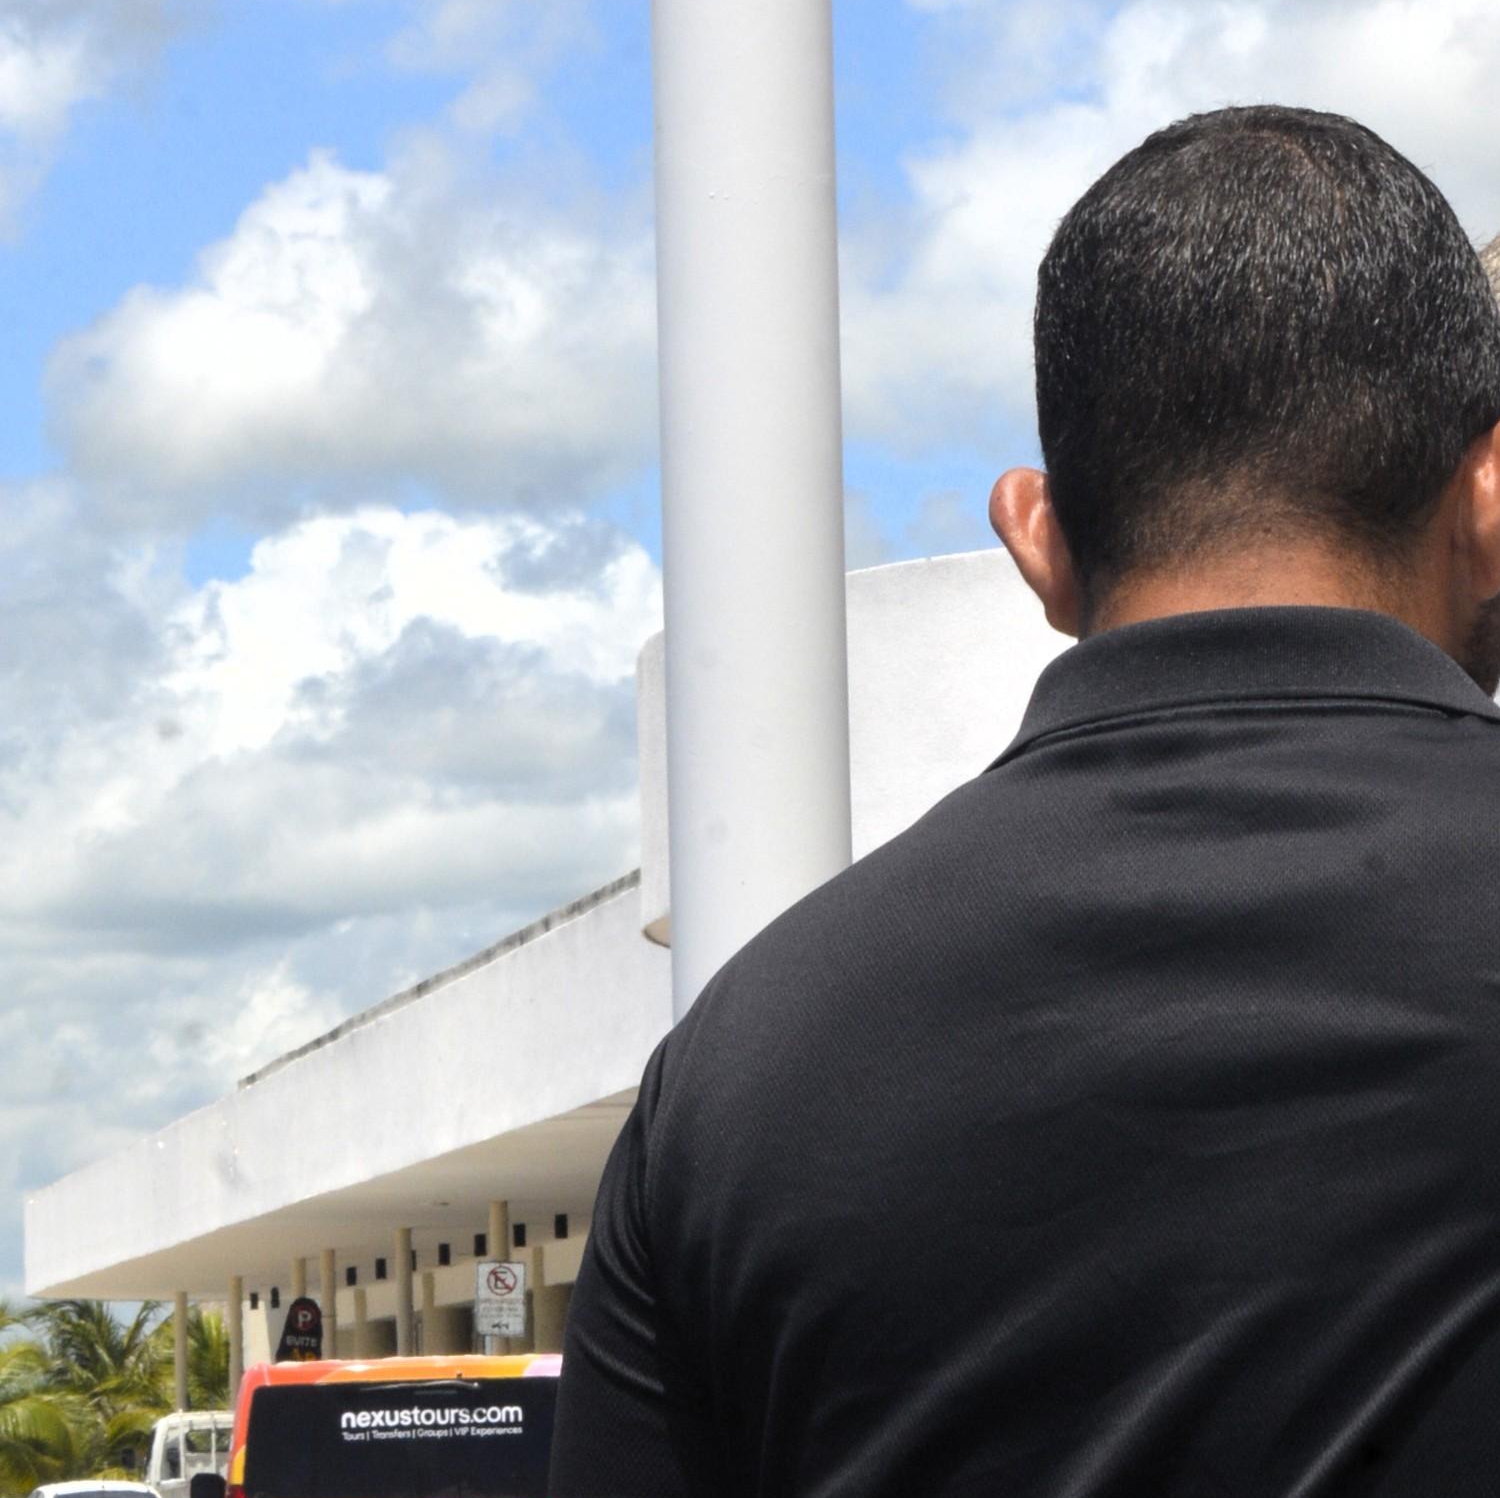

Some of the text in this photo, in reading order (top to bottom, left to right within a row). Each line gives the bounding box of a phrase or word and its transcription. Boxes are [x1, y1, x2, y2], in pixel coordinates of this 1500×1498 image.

[341, 1406, 523, 1428] nexustours.com
[342, 1426, 523, 1441] Tours Transfers Groups VIP Experiences
